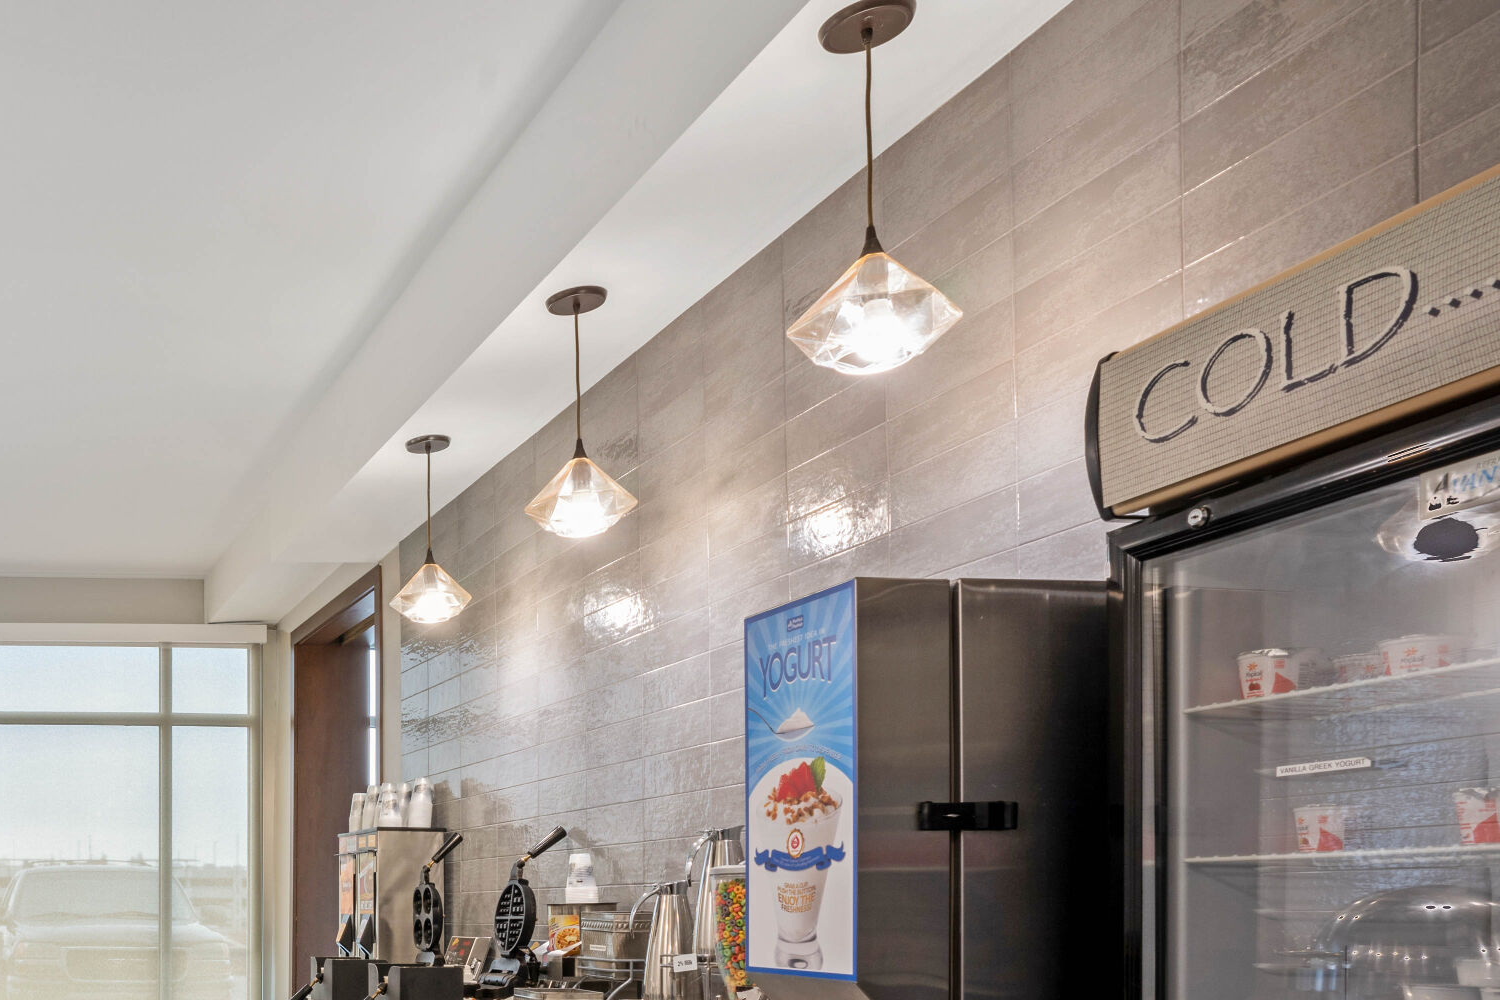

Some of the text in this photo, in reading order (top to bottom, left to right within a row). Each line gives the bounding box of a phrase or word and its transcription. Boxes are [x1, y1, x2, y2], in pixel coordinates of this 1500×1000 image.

[759, 634, 837, 700] YOGURT
[1280, 758, 1365, 775] VANILLA GREEK YOGURT
[778, 893, 816, 906] ENJOY THE
